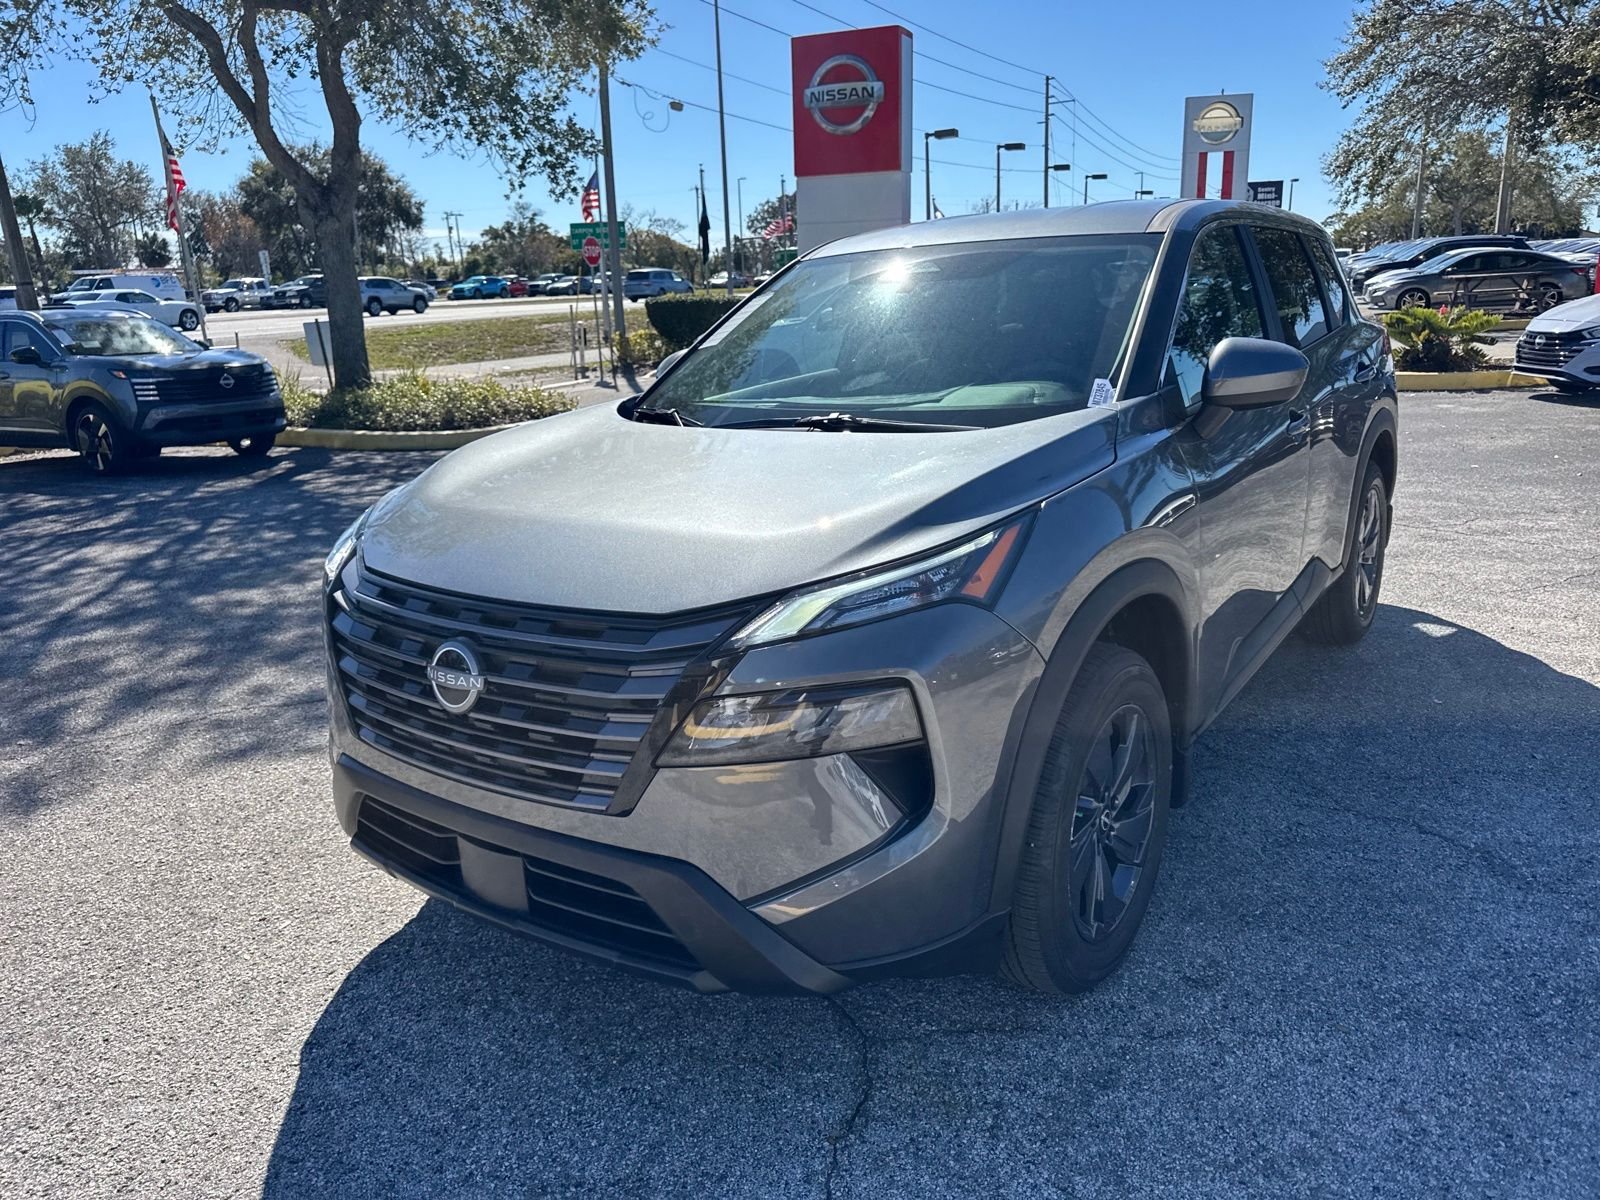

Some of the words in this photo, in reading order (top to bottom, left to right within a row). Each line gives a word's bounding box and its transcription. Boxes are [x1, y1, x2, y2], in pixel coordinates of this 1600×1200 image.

[809, 86, 875, 104] NISSAN
[584, 245, 601, 258] STOP
[427, 666, 481, 688] NISSAN
